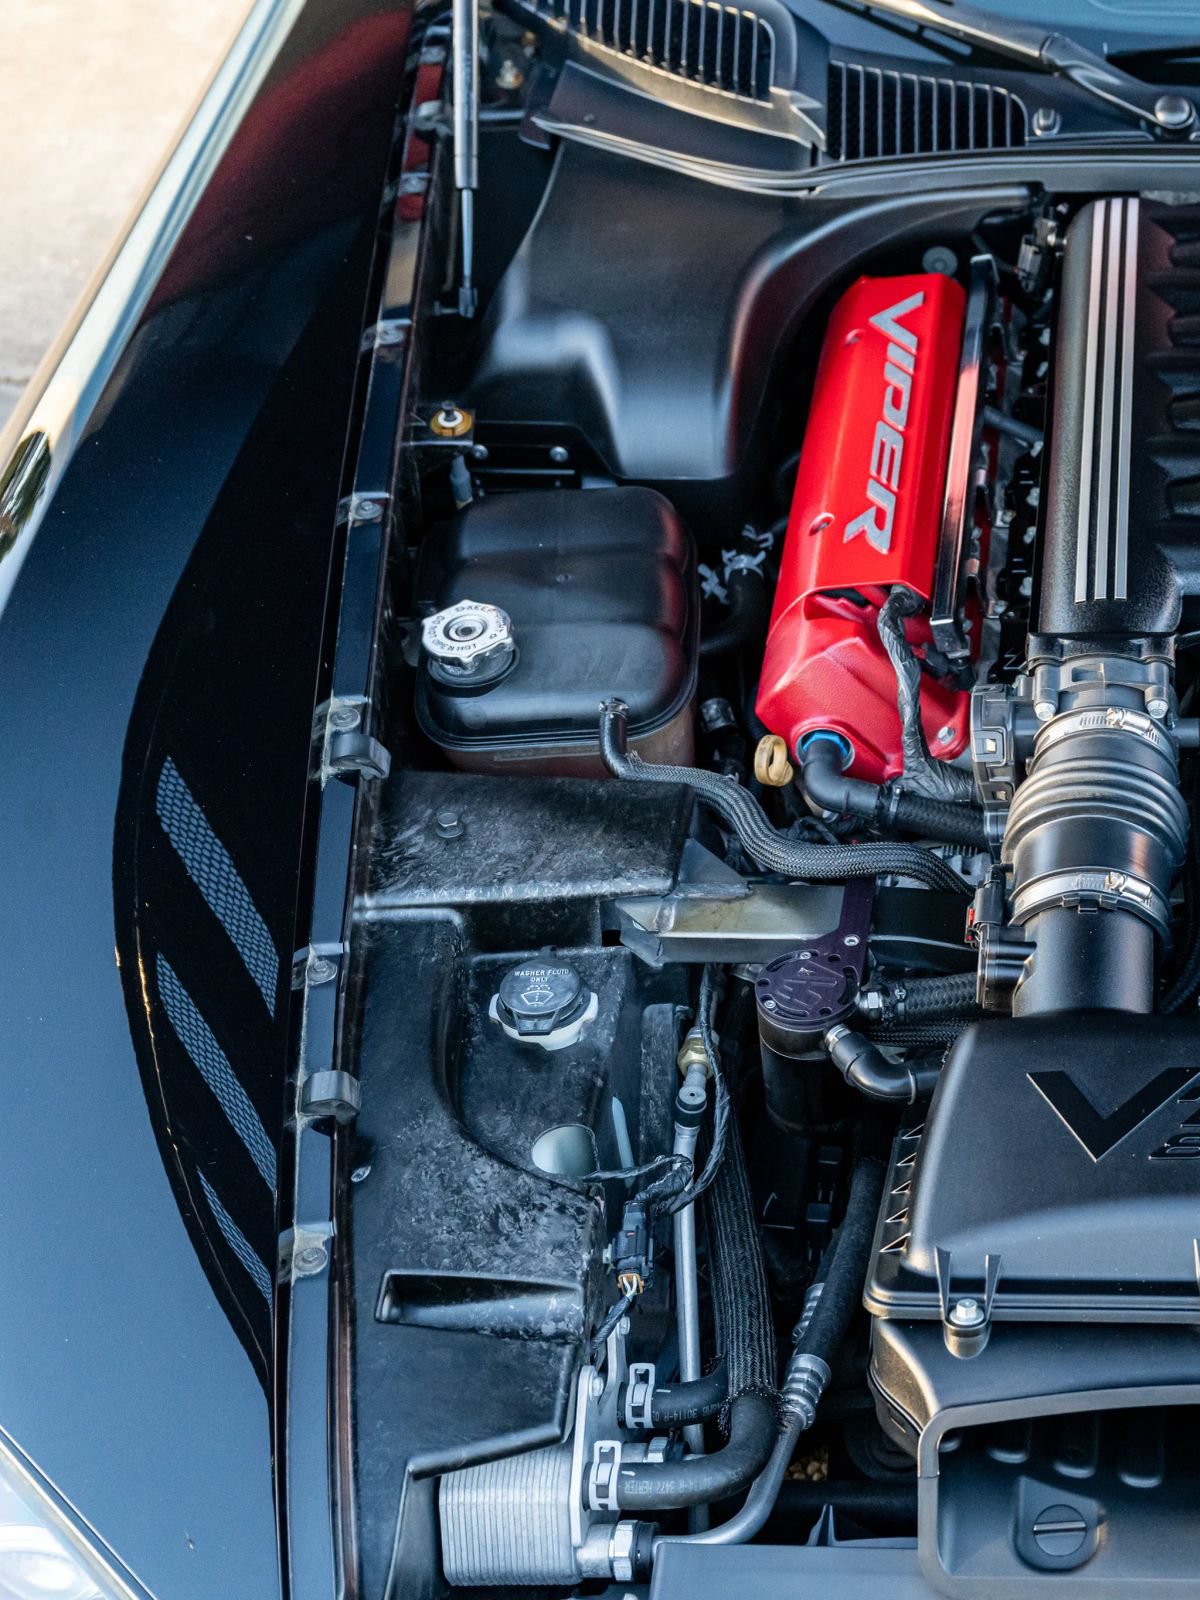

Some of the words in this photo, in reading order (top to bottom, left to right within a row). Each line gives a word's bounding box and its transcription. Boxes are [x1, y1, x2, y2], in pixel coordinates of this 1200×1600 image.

[843, 290, 925, 555] VIPER
[514, 969, 546, 977] WASHER
[547, 968, 570, 976] FLUID
